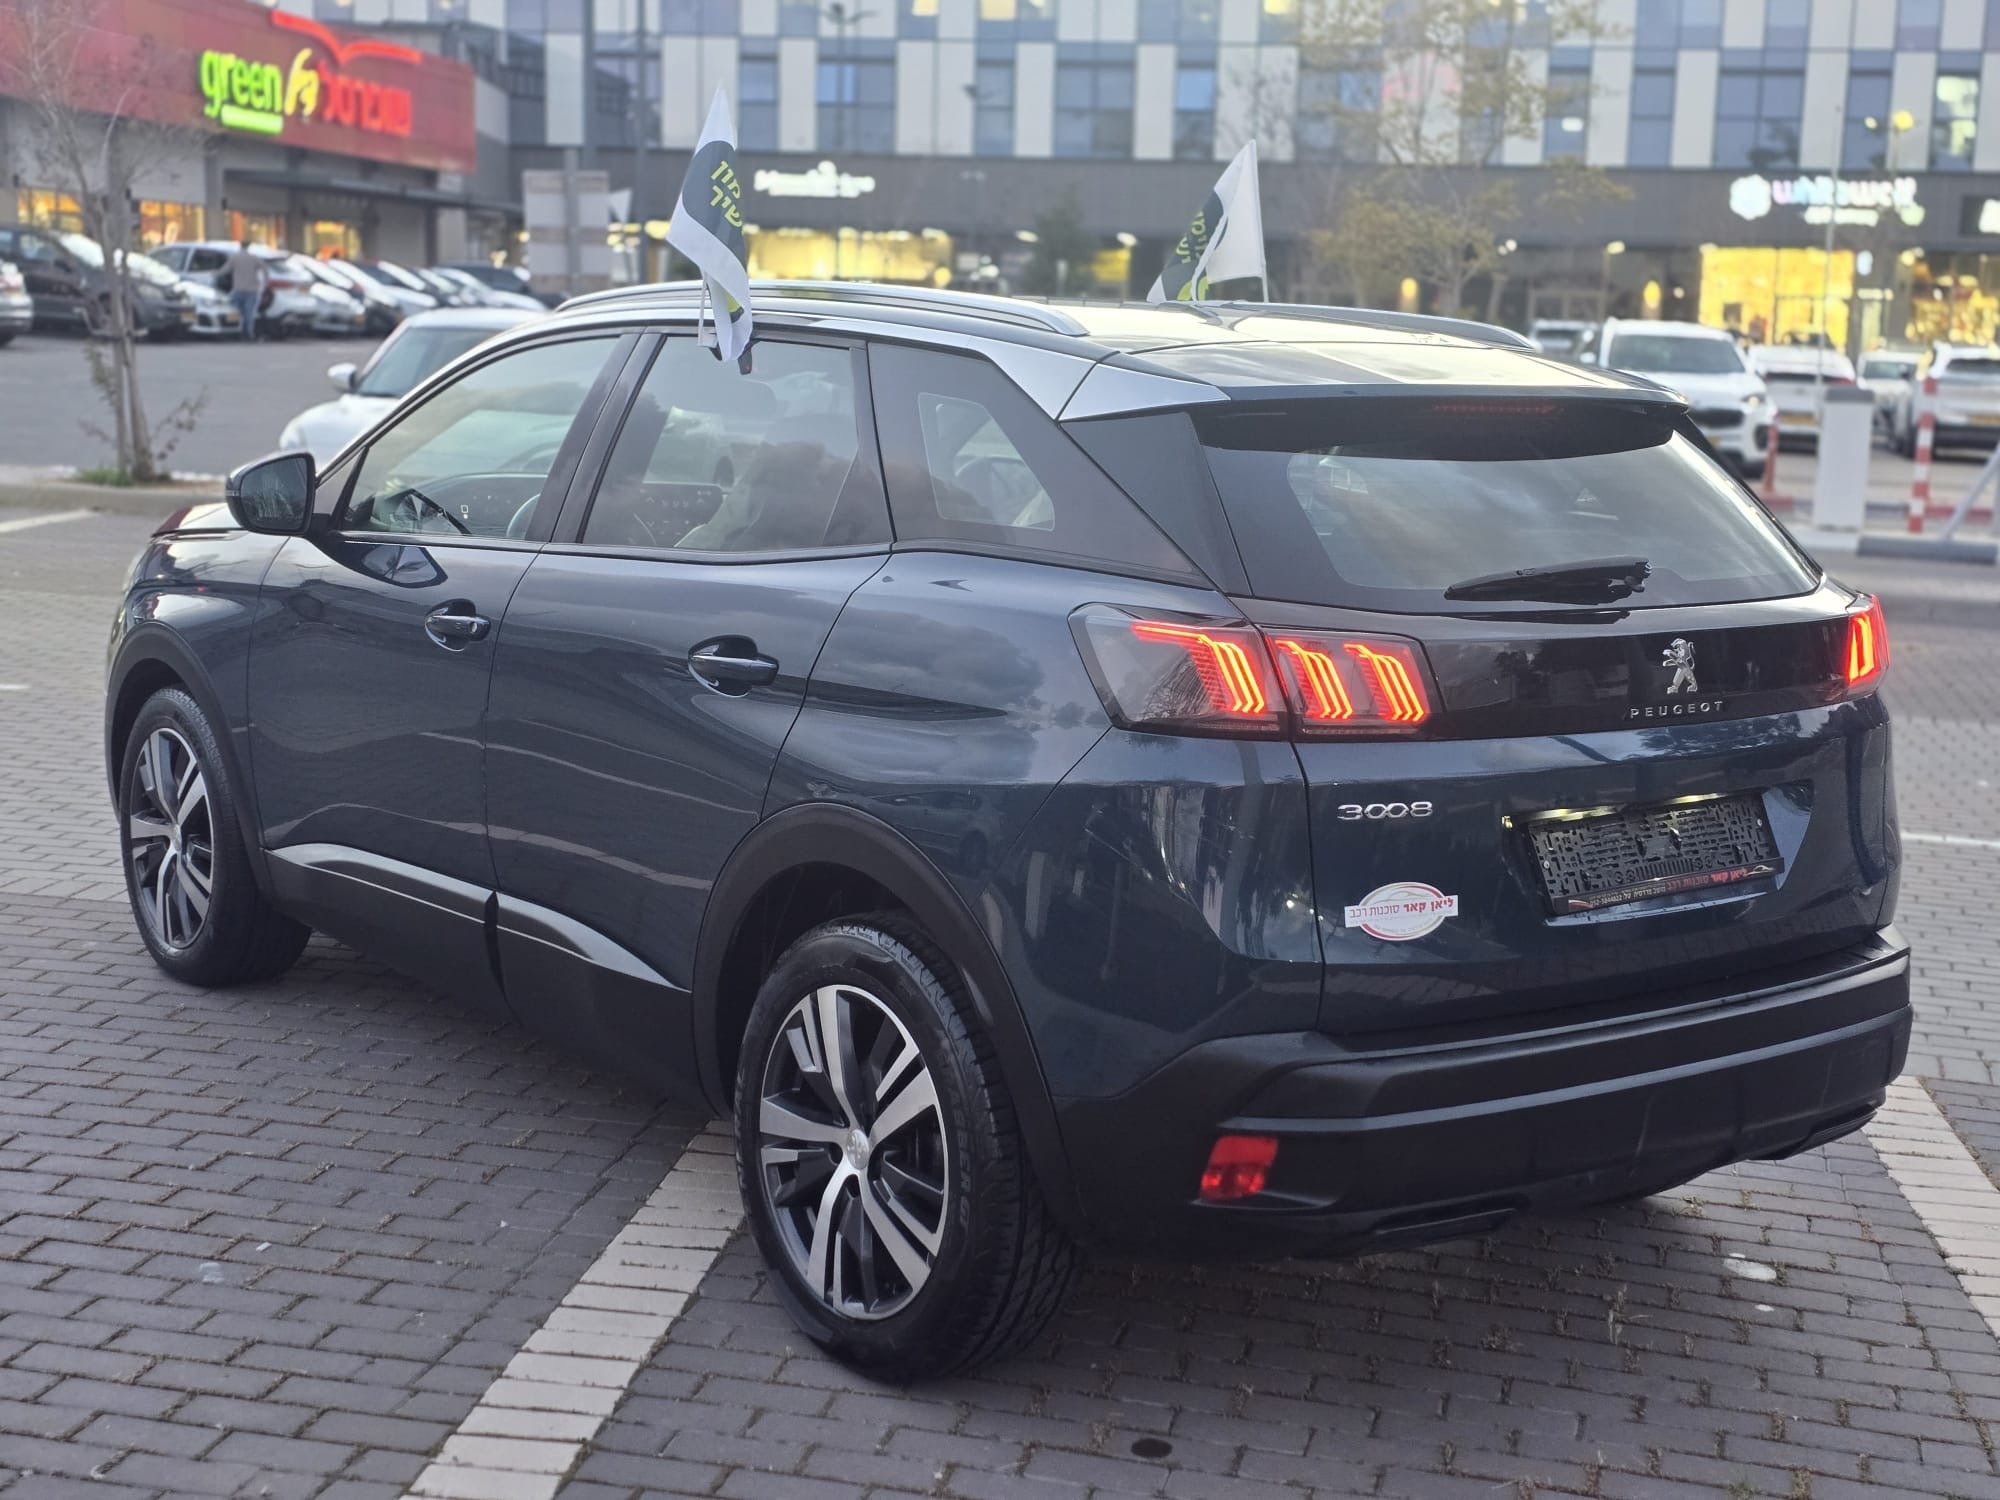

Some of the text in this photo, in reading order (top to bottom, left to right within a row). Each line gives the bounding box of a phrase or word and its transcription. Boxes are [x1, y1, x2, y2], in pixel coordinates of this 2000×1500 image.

[201, 50, 282, 118] green
[1630, 701, 1723, 719] PEUGEOT
[1337, 801, 1433, 820] 3008
[1349, 897, 1454, 918] ליאן קאר סוכנות רכב
